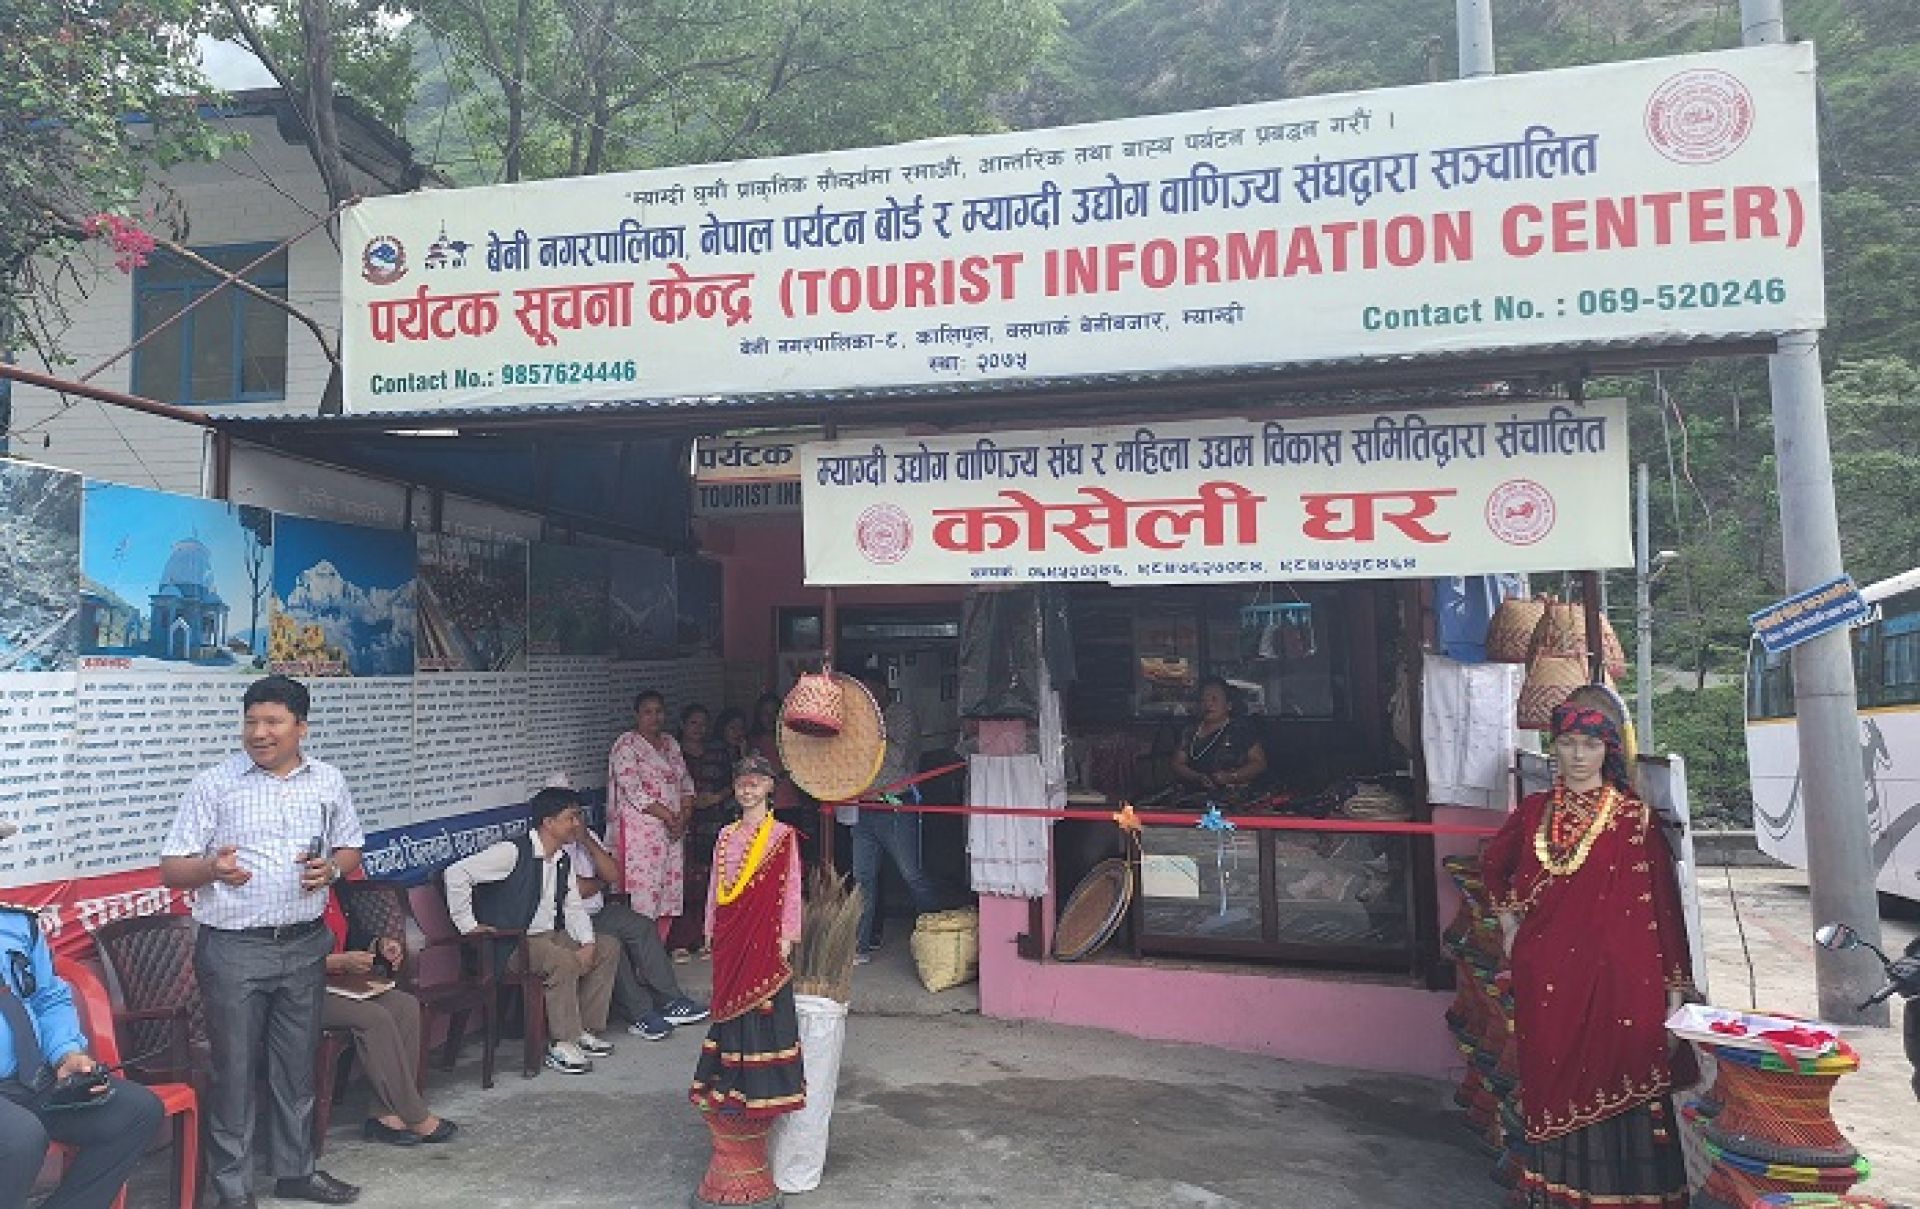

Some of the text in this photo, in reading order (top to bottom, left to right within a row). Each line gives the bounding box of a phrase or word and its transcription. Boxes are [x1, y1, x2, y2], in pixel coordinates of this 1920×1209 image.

[1074, 144, 1113, 165] तथा
[1184, 126, 1246, 151] पर्यटन
[486, 227, 530, 273] बेनी
[699, 210, 775, 256] नेपाल
[782, 203, 868, 251] पर्यटन
[874, 194, 925, 243] बोर्ड
[932, 200, 954, 238] र
[962, 180, 1063, 233] म्याग्दी
[1071, 172, 1151, 225] उद्योग
[1159, 161, 1283, 215] वाणिज्य
[1292, 152, 1420, 207] संघद्वारा
[1430, 125, 1600, 190] सञ्चालित
[368, 185, 1806, 347] पर्यटक सूचना केन्द्र (TOURIST INFORMATION CENTER)
[1181, 300, 1246, 326] म्याग्दी
[1362, 297, 1482, 331] Contact
[1578, 276, 1787, 317] 069-520246
[370, 370, 448, 396] Contact
[501, 360, 637, 387] 9857624446
[697, 440, 795, 469] पर्यटक
[816, 405, 1608, 486] म्याग्दी उद्योग वाणिज्य संघ र महिला उद्यम विकास समितिद्वारा संचालित
[699, 482, 772, 508] TOURIST
[931, 479, 1267, 555] कोसेली
[1299, 486, 1458, 544] घर
